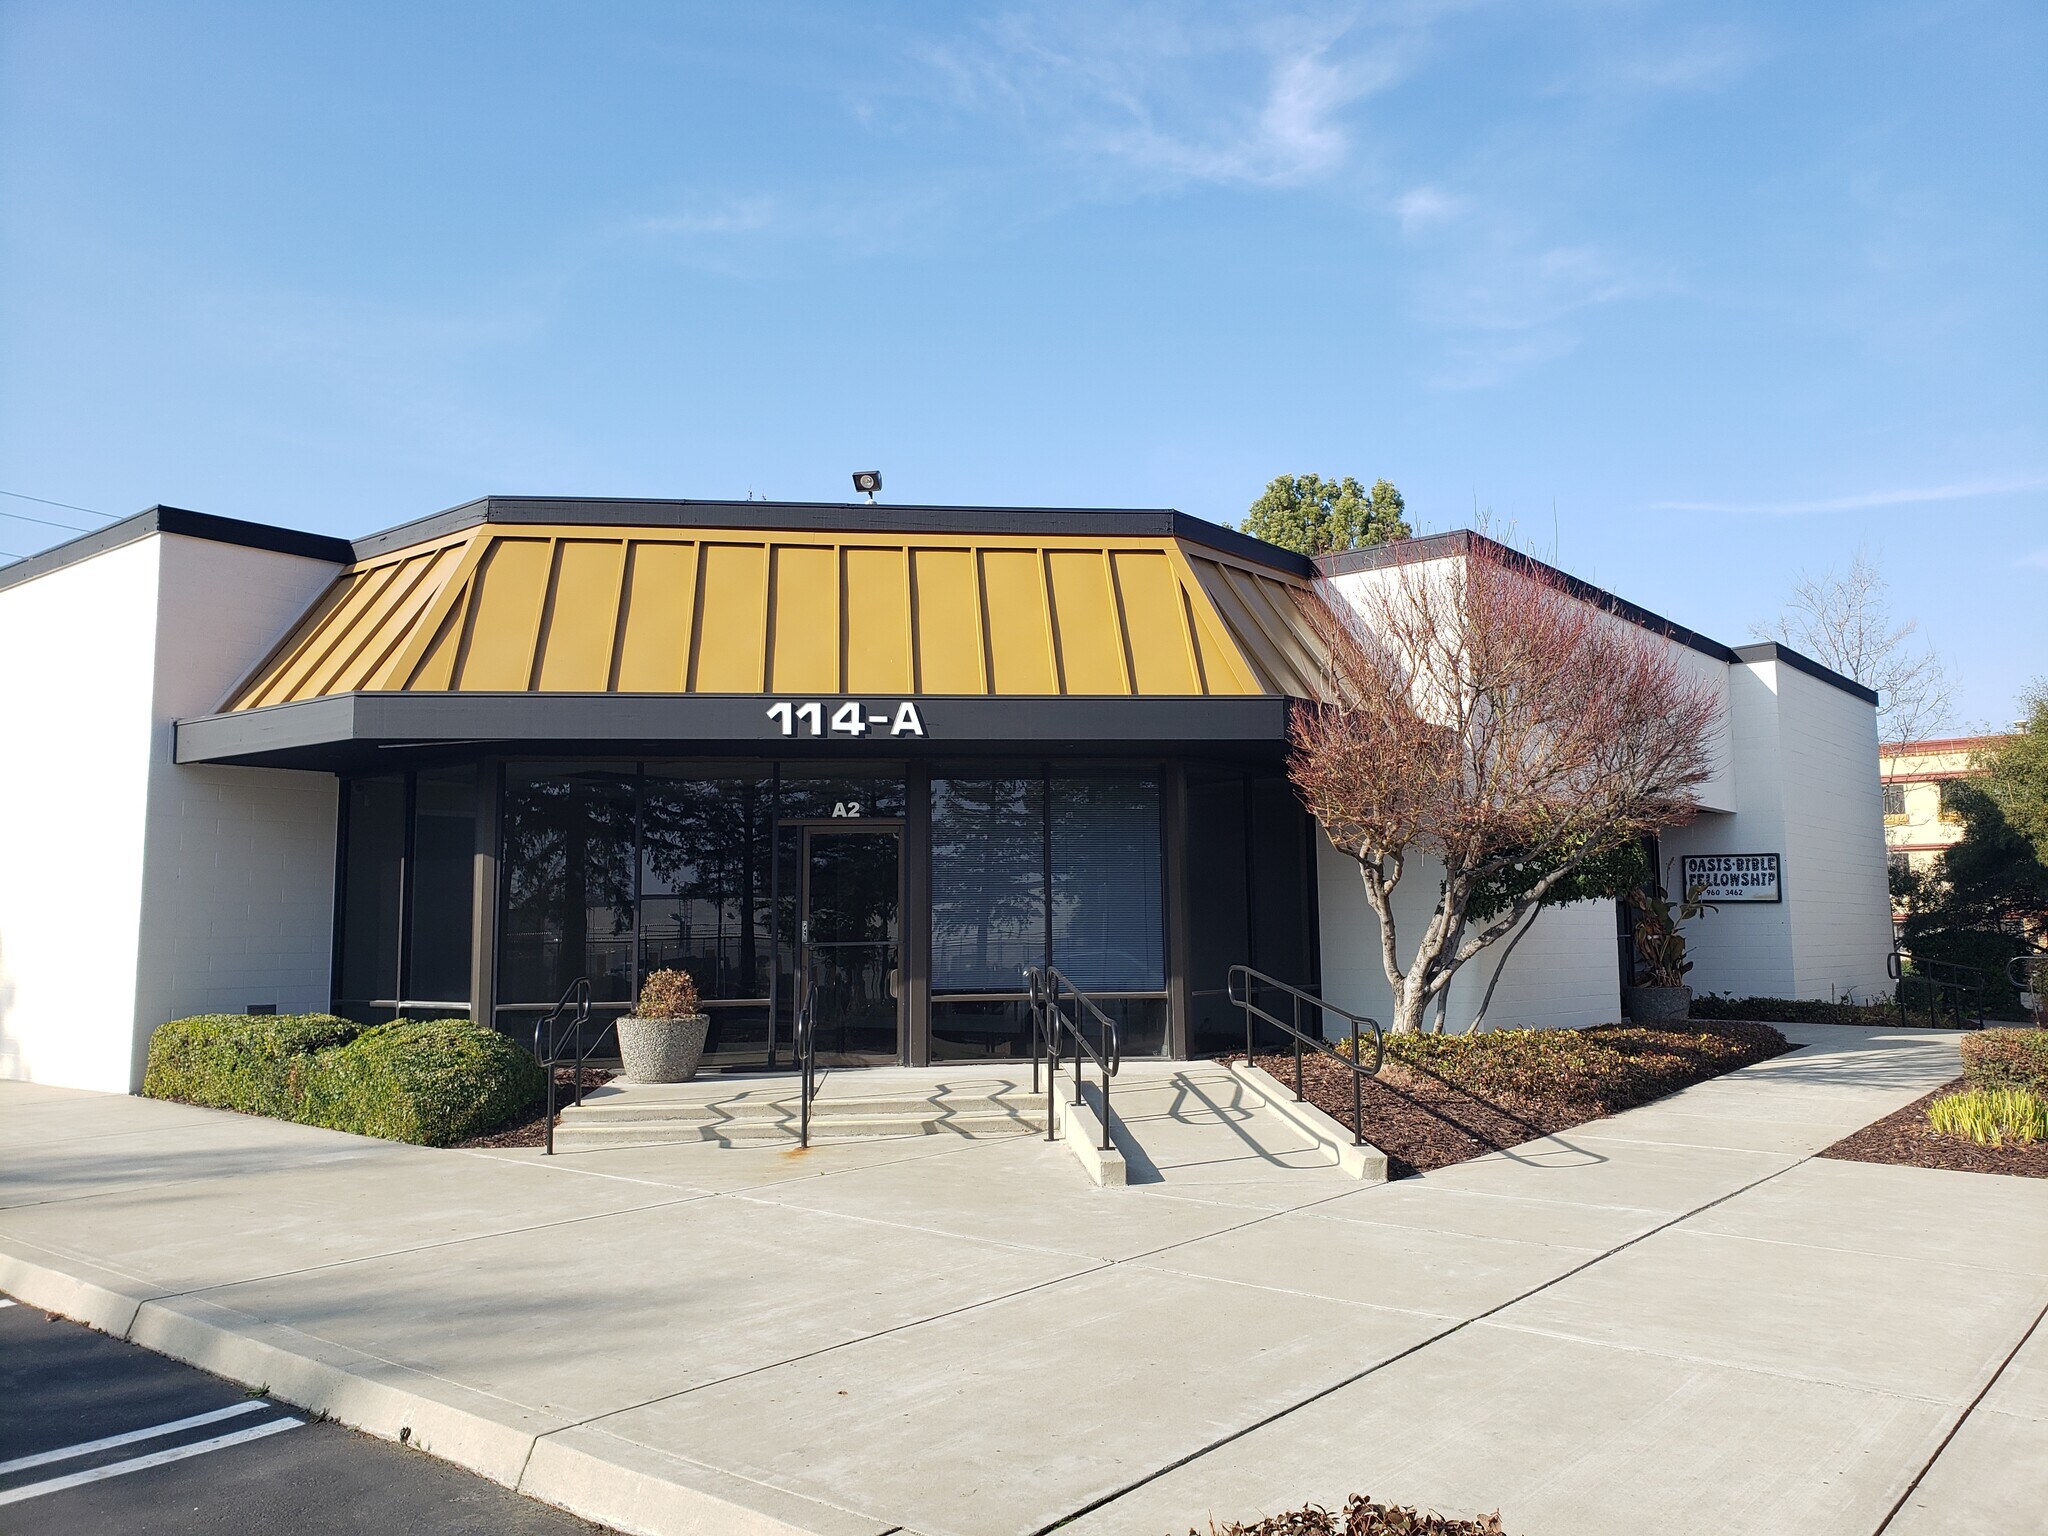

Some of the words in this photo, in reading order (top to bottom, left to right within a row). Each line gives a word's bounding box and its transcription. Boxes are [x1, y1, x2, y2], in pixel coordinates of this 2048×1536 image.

[766, 702, 924, 736] 114-A
[832, 802, 860, 818] A2
[1688, 872, 1776, 887] FELLOWSHIP
